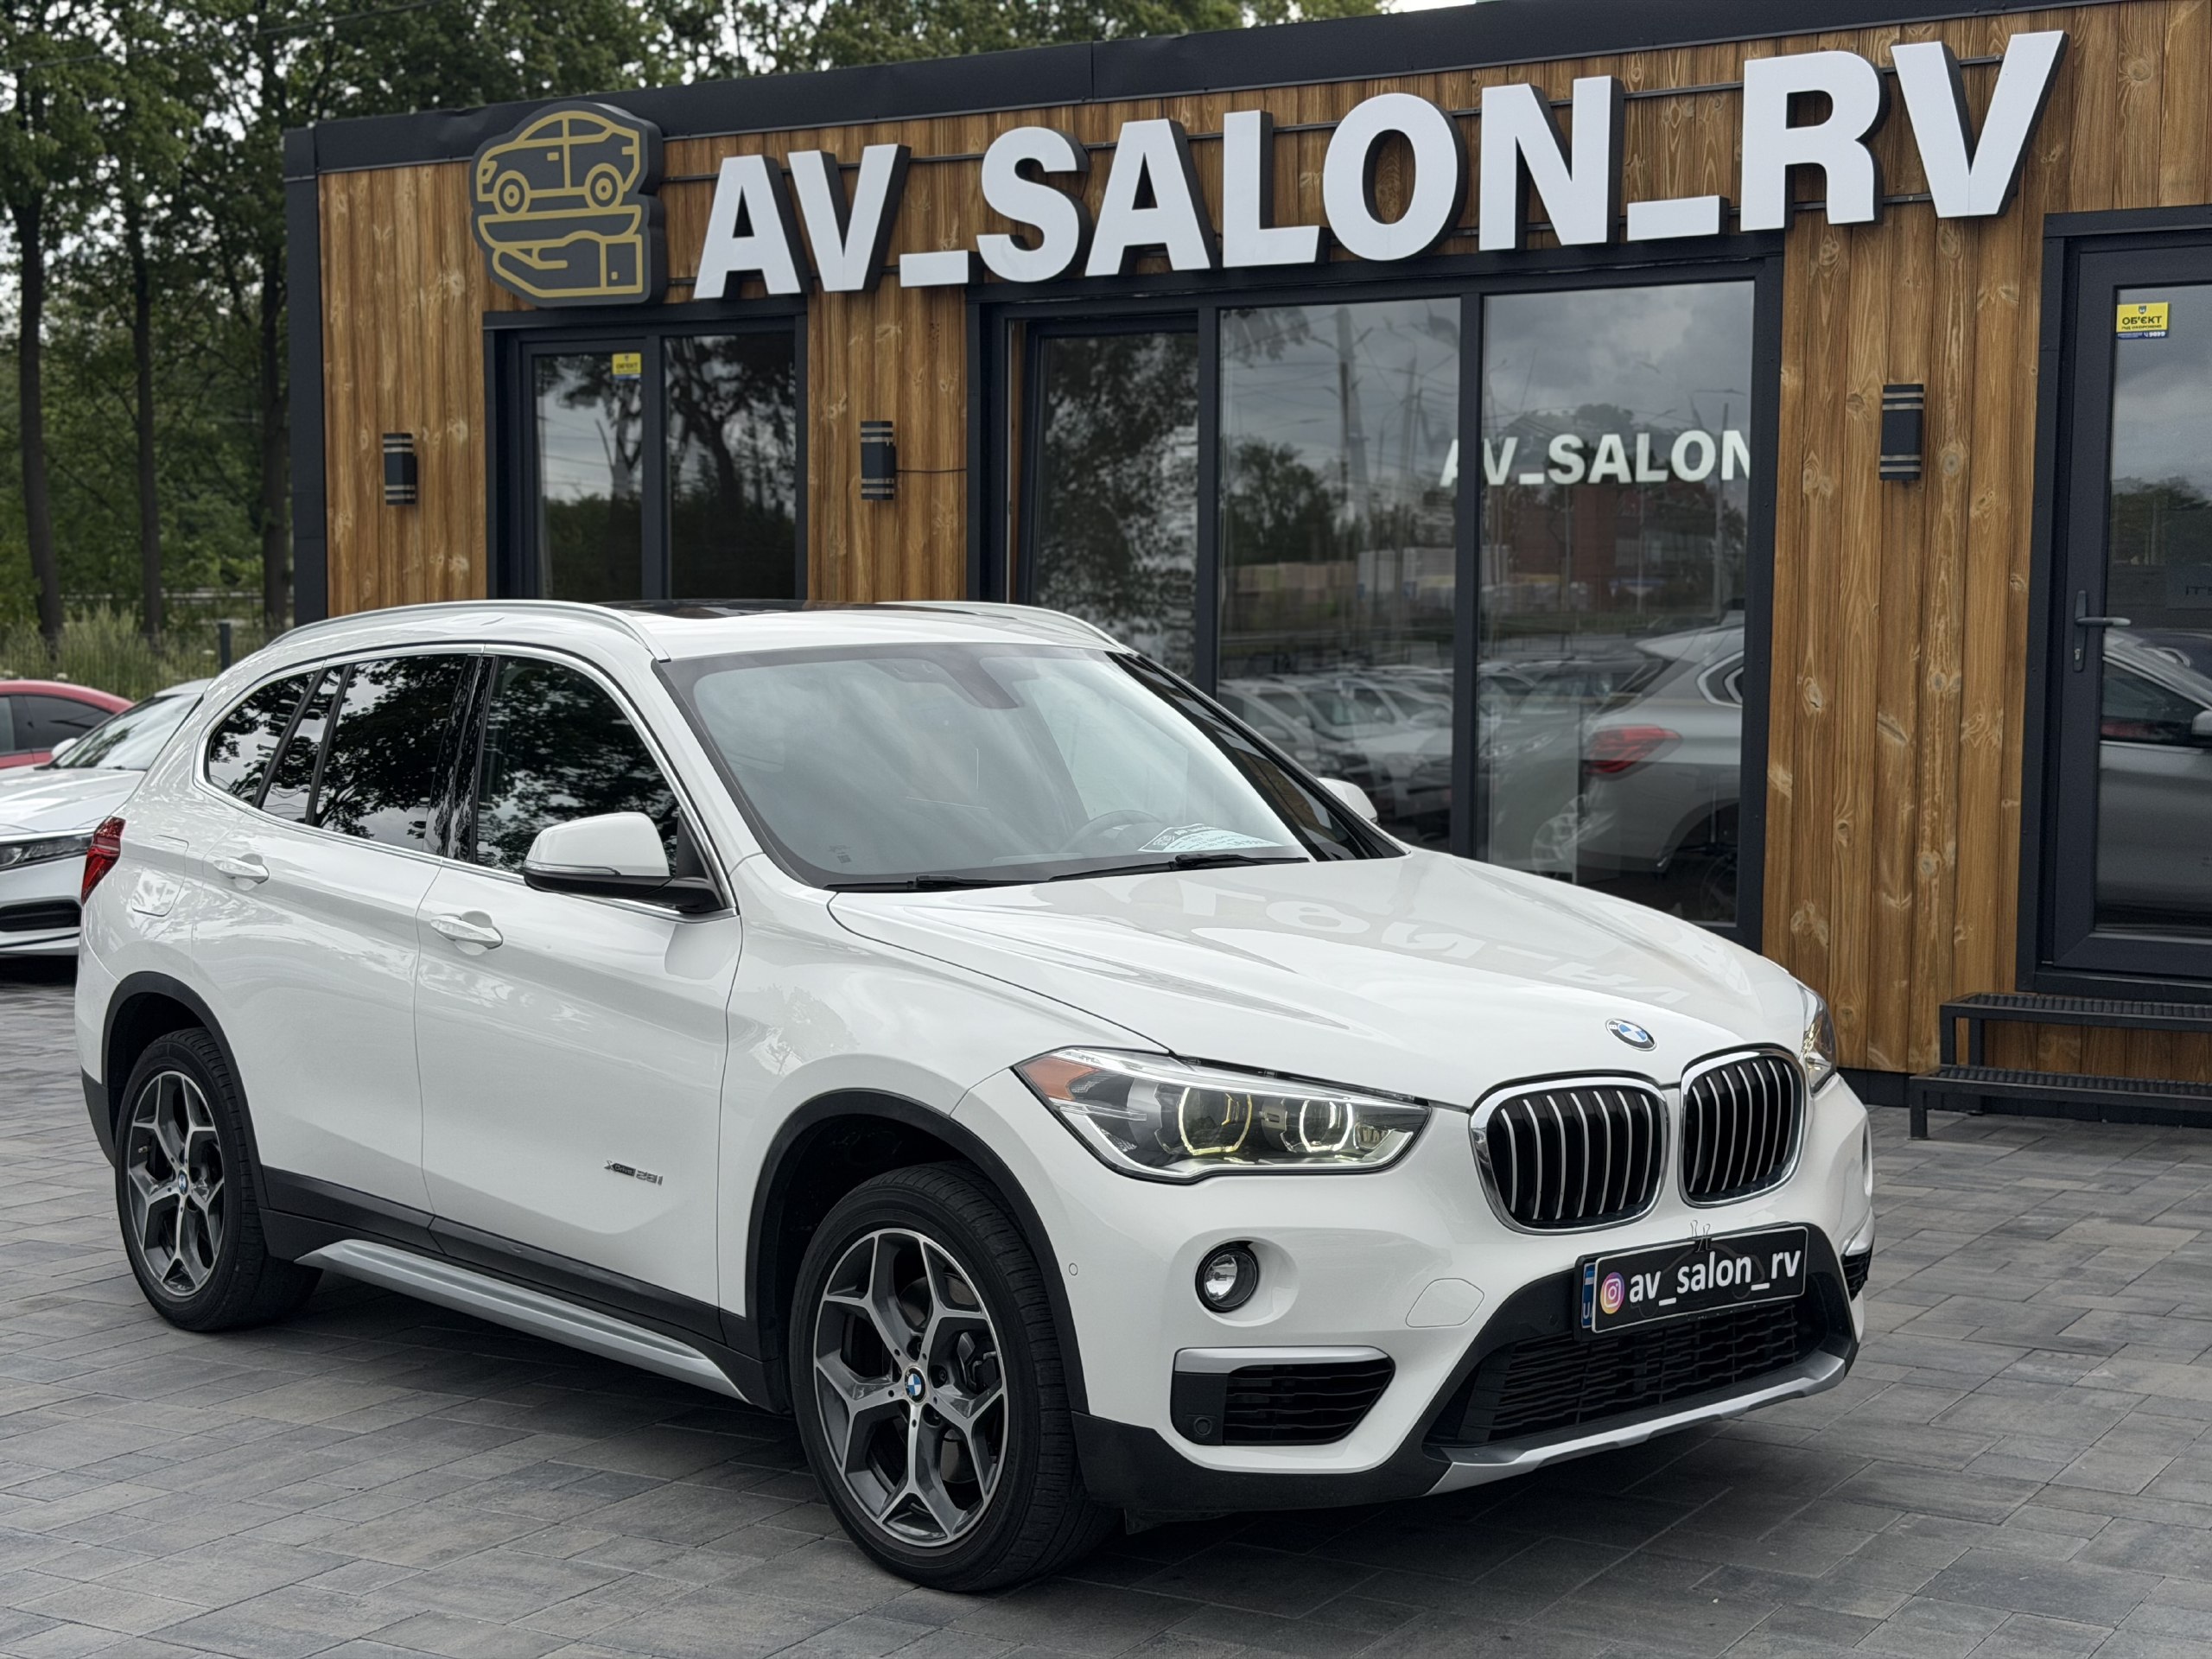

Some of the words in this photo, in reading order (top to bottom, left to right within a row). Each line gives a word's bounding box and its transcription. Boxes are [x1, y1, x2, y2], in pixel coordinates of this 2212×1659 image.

[694, 30, 2067, 300] AV_SALON_RV
[1629, 1250, 1802, 1306] av_salon_rv
[1583, 1301, 1593, 1319] U
